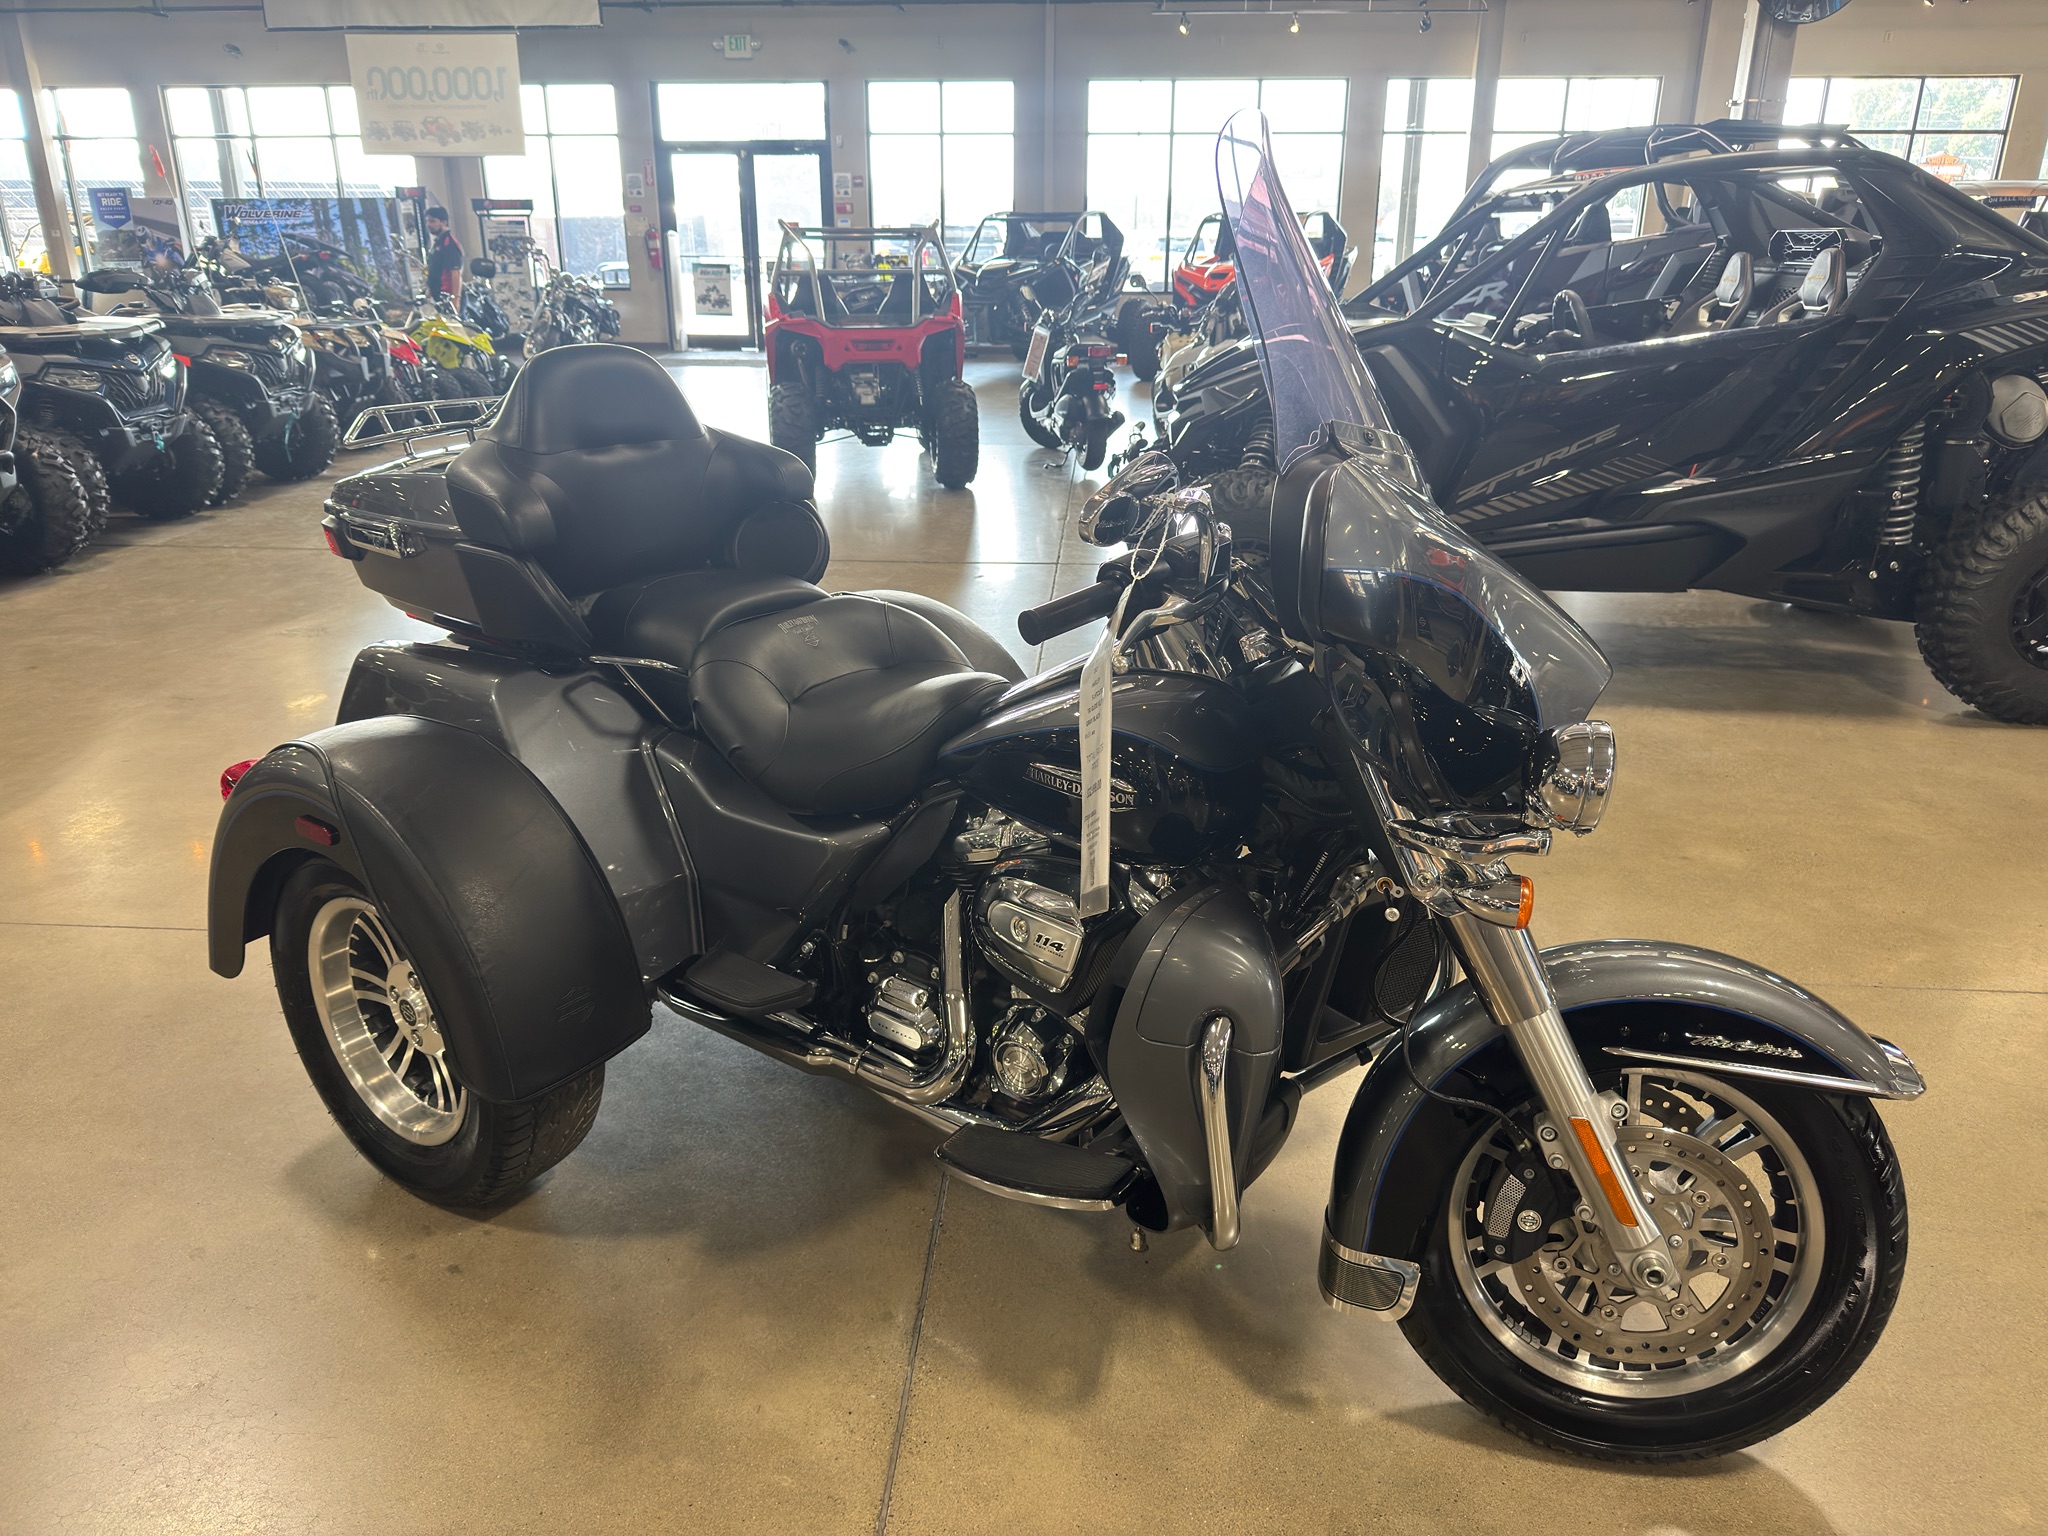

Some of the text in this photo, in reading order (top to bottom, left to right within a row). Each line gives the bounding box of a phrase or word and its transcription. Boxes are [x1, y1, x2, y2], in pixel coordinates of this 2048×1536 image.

[728, 35, 747, 51] EXIT
[101, 197, 123, 206] RIDE
[1456, 424, 1621, 504] ZFORCE
[1029, 767, 1135, 806] HARLEY-DSON
[1034, 933, 1067, 953] 114
